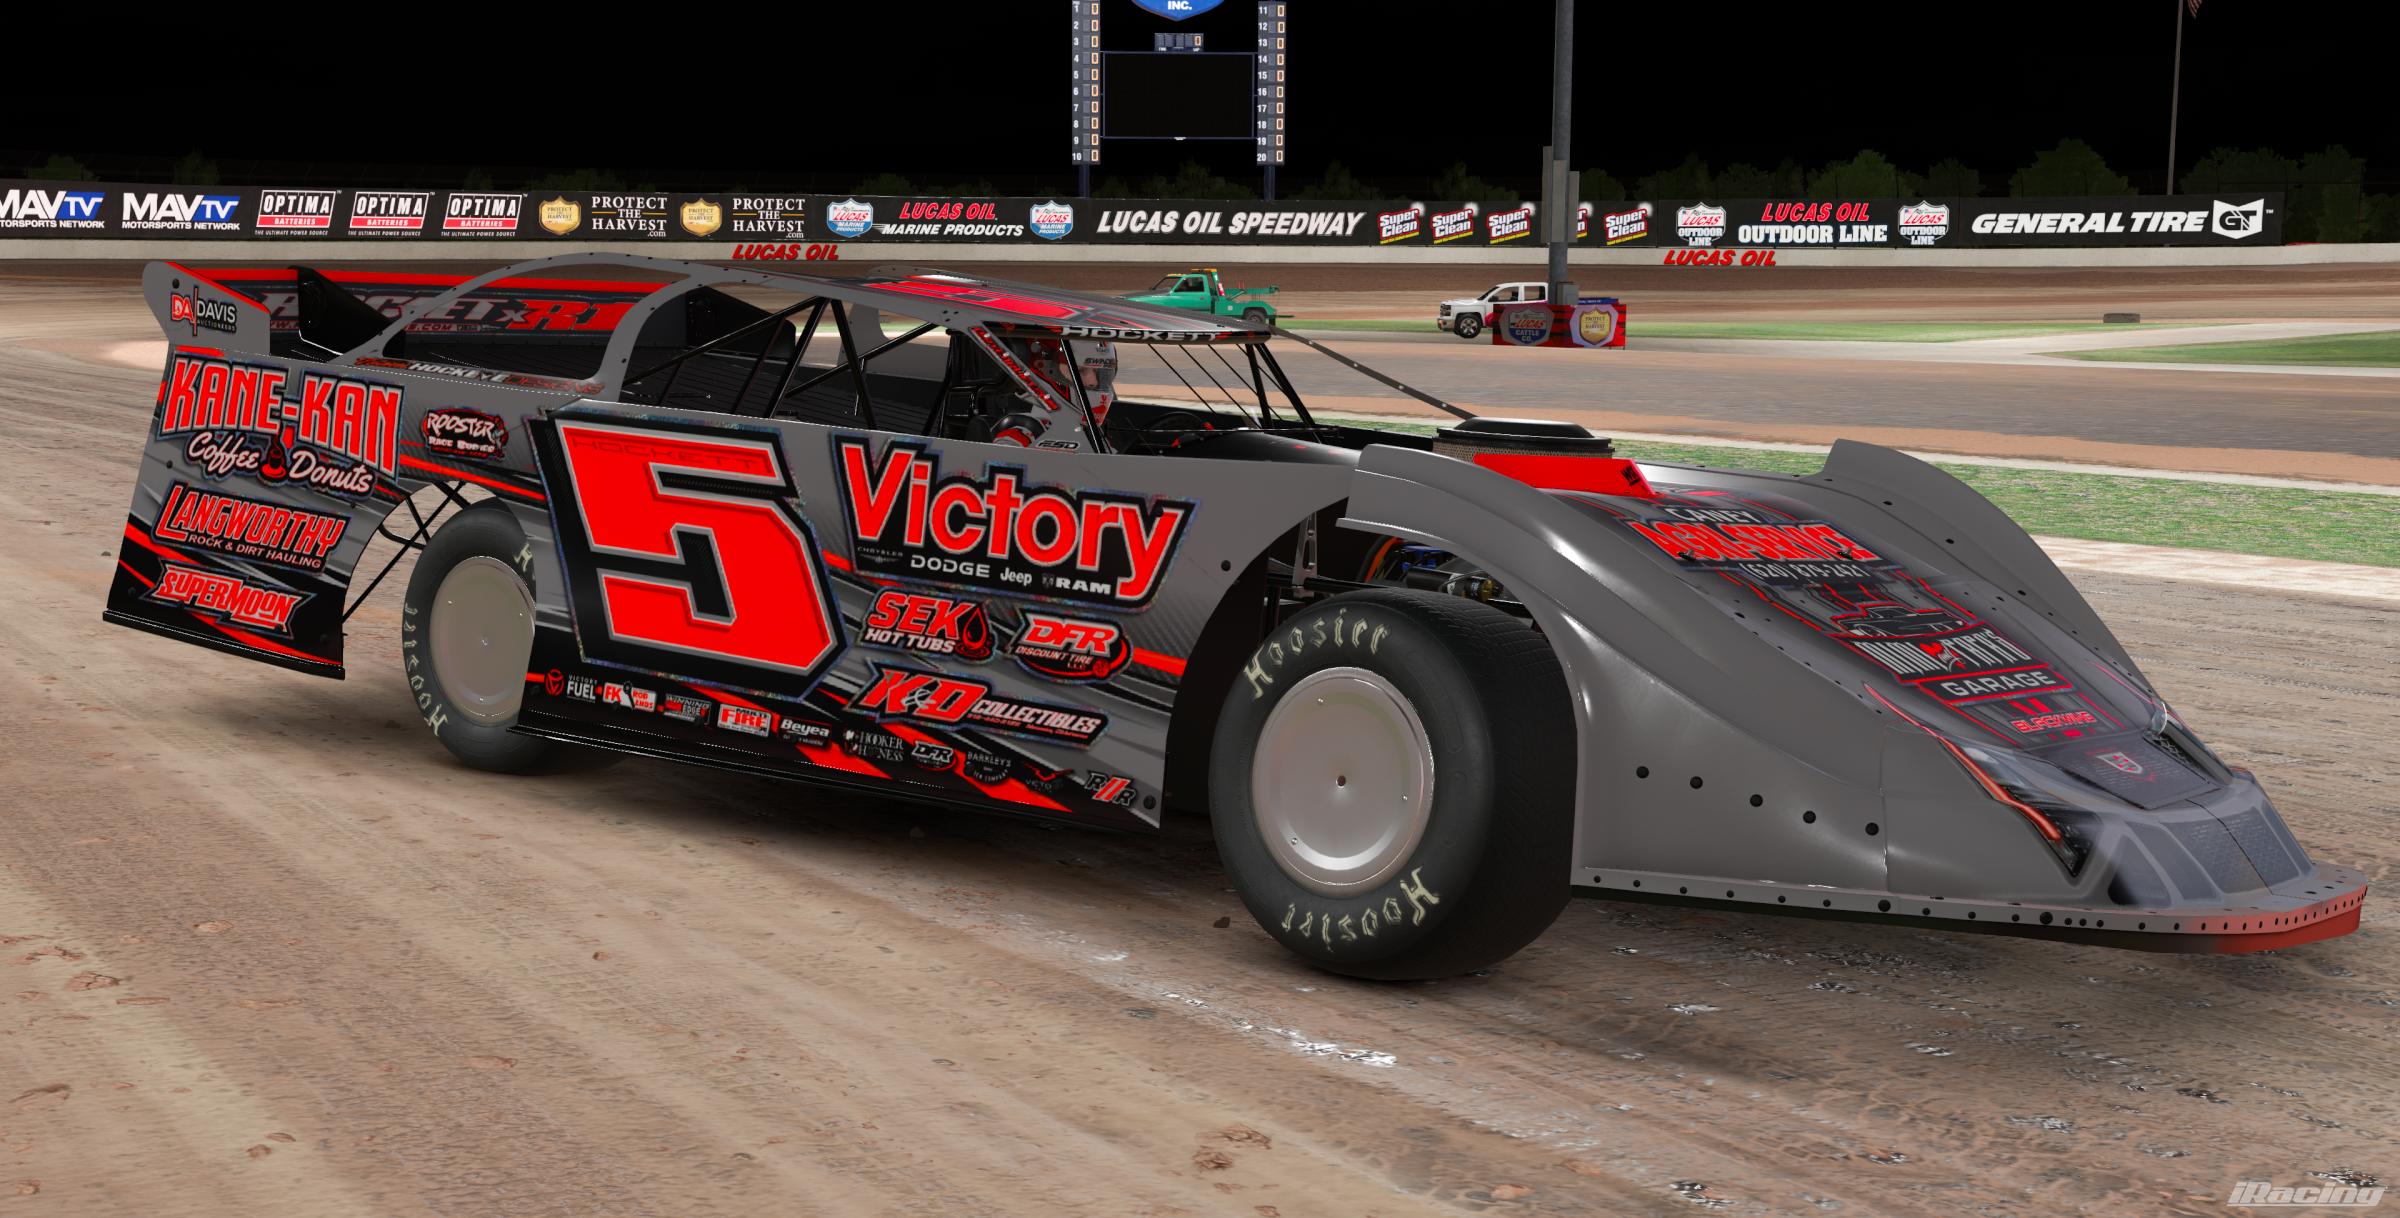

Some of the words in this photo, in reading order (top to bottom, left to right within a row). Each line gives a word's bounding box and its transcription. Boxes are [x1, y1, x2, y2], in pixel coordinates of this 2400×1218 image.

[1168, 1, 1192, 10] INC.
[1258, 6, 1267, 14] 11
[1258, 55, 1267, 63] 14
[1257, 88, 1267, 96] 16
[1257, 153, 1267, 161] 20
[122, 193, 239, 221] MAVTV
[262, 194, 330, 214] OPTIMA
[356, 197, 423, 215] OPTIMA
[450, 199, 516, 217] OPTIMA
[592, 196, 667, 209] PROTECT
[733, 198, 805, 210] PROTECT
[617, 210, 640, 218] THE
[757, 211, 780, 220] THE
[833, 212, 868, 221] LUCAS
[900, 202, 963, 220] LUCAS
[966, 203, 996, 220] OIL
[1035, 213, 1070, 223] LUCAS
[1380, 209, 1418, 227] Super
[1432, 209, 1472, 227] Super
[1488, 209, 1531, 227] Super
[1605, 209, 1646, 228] Super
[1761, 202, 1832, 221] LUCAS
[1835, 202, 1869, 221] OIL
[1904, 213, 1945, 225] LUCAS
[0, 220, 57, 229] TORSPORTS
[60, 221, 104, 229] NETWORK
[121, 221, 191, 230] MOTORSPORTS
[193, 222, 240, 231] NETWORK
[274, 218, 317, 226] BATTERIES
[367, 219, 409, 227] BATTERIES
[461, 220, 503, 228] BATTERIES
[592, 219, 667, 230] HARVEST
[733, 220, 805, 232] HARVEST
[1097, 210, 1179, 233] LUCAS
[1183, 211, 1223, 234] OIL
[1228, 212, 1367, 236] SPEEDWAY
[1490, 220, 1529, 237] Clean
[1681, 215, 1721, 226] LUCAS
[1971, 212, 2123, 234] GENERAL
[2130, 211, 2209, 233] TIRE
[647, 230, 666, 238] .com
[881, 224, 941, 236] MARINE
[944, 224, 1024, 236] PRODUCTS
[1381, 221, 1417, 237] Clean
[1434, 221, 1471, 237] Clean
[1608, 221, 1645, 238] Clean
[1678, 227, 1723, 237] OUTDOOR
[1738, 225, 1836, 243] OUTDOOR
[1839, 225, 1888, 243] LINE
[1900, 226, 1946, 236] OUTDOOR
[1689, 237, 1712, 246] LINE
[1910, 235, 1934, 245] LINE
[732, 244, 801, 260] LUCAS
[805, 244, 839, 260] OIL
[1663, 250, 1736, 265] LUCAS
[1740, 250, 1776, 266] OIL
[197, 300, 236, 323] DAVIS
[1513, 319, 1544, 328] LUCAS
[1061, 327, 1217, 341] HOCKETT
[160, 357, 403, 476] KANE-KAN
[427, 413, 495, 442] ROOSTER
[188, 431, 260, 474] Coffee
[289, 450, 373, 493] Donuts
[155, 485, 346, 558] LANGWORTHY
[842, 442, 1185, 601] Victory
[1664, 507, 1761, 523] CANEY
[556, 421, 837, 676] 5
[1627, 521, 1883, 561] AGRI-SERVICE
[189, 534, 222, 549] ROCK
[225, 541, 233, 551] &
[236, 544, 262, 556] DIRT
[265, 549, 321, 569] HAULING
[910, 554, 991, 579] DODGE
[1000, 566, 1033, 587] Jeep
[1055, 577, 1112, 596] RAM
[868, 591, 976, 641] SEK
[864, 628, 898, 644] HOT
[907, 635, 958, 654] TUBS
[1020, 614, 1121, 657] DFR
[1015, 646, 1068, 661] DISCOUNT
[566, 681, 596, 700] FUEL
[1941, 670, 2057, 697] GARAGE
[605, 685, 623, 703] FK
[859, 668, 988, 723] K&D
[971, 700, 1101, 734] COLLECTIBLES
[721, 707, 767, 728] FIRE
[780, 718, 830, 738] Beyea
